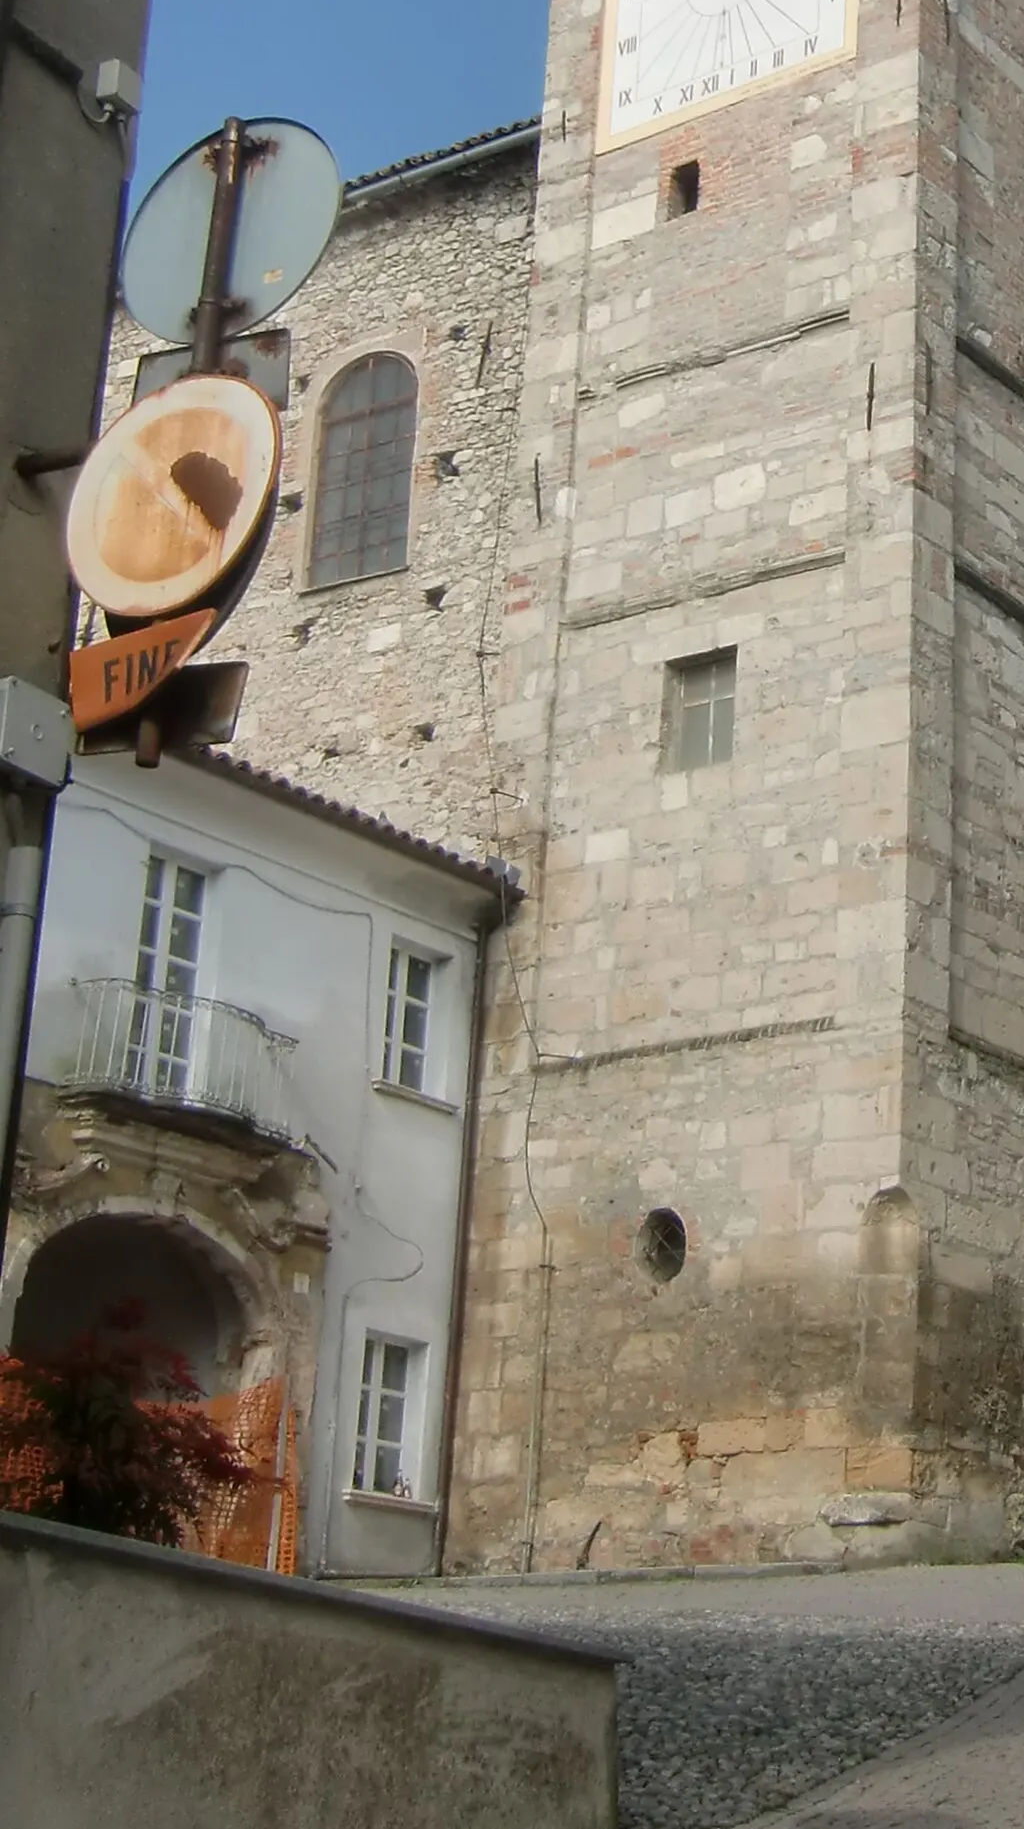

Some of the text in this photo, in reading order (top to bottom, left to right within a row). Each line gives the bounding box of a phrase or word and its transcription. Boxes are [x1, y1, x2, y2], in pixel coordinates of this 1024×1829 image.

[617, 36, 638, 56] VIII
[804, 36, 818, 57] IV
[750, 59, 758, 77] II
[772, 48, 785, 69] III
[701, 74, 720, 96] XII
[729, 68, 735, 86] I
[618, 88, 633, 108] IX
[679, 84, 695, 105] XI
[652, 96, 664, 116] X
